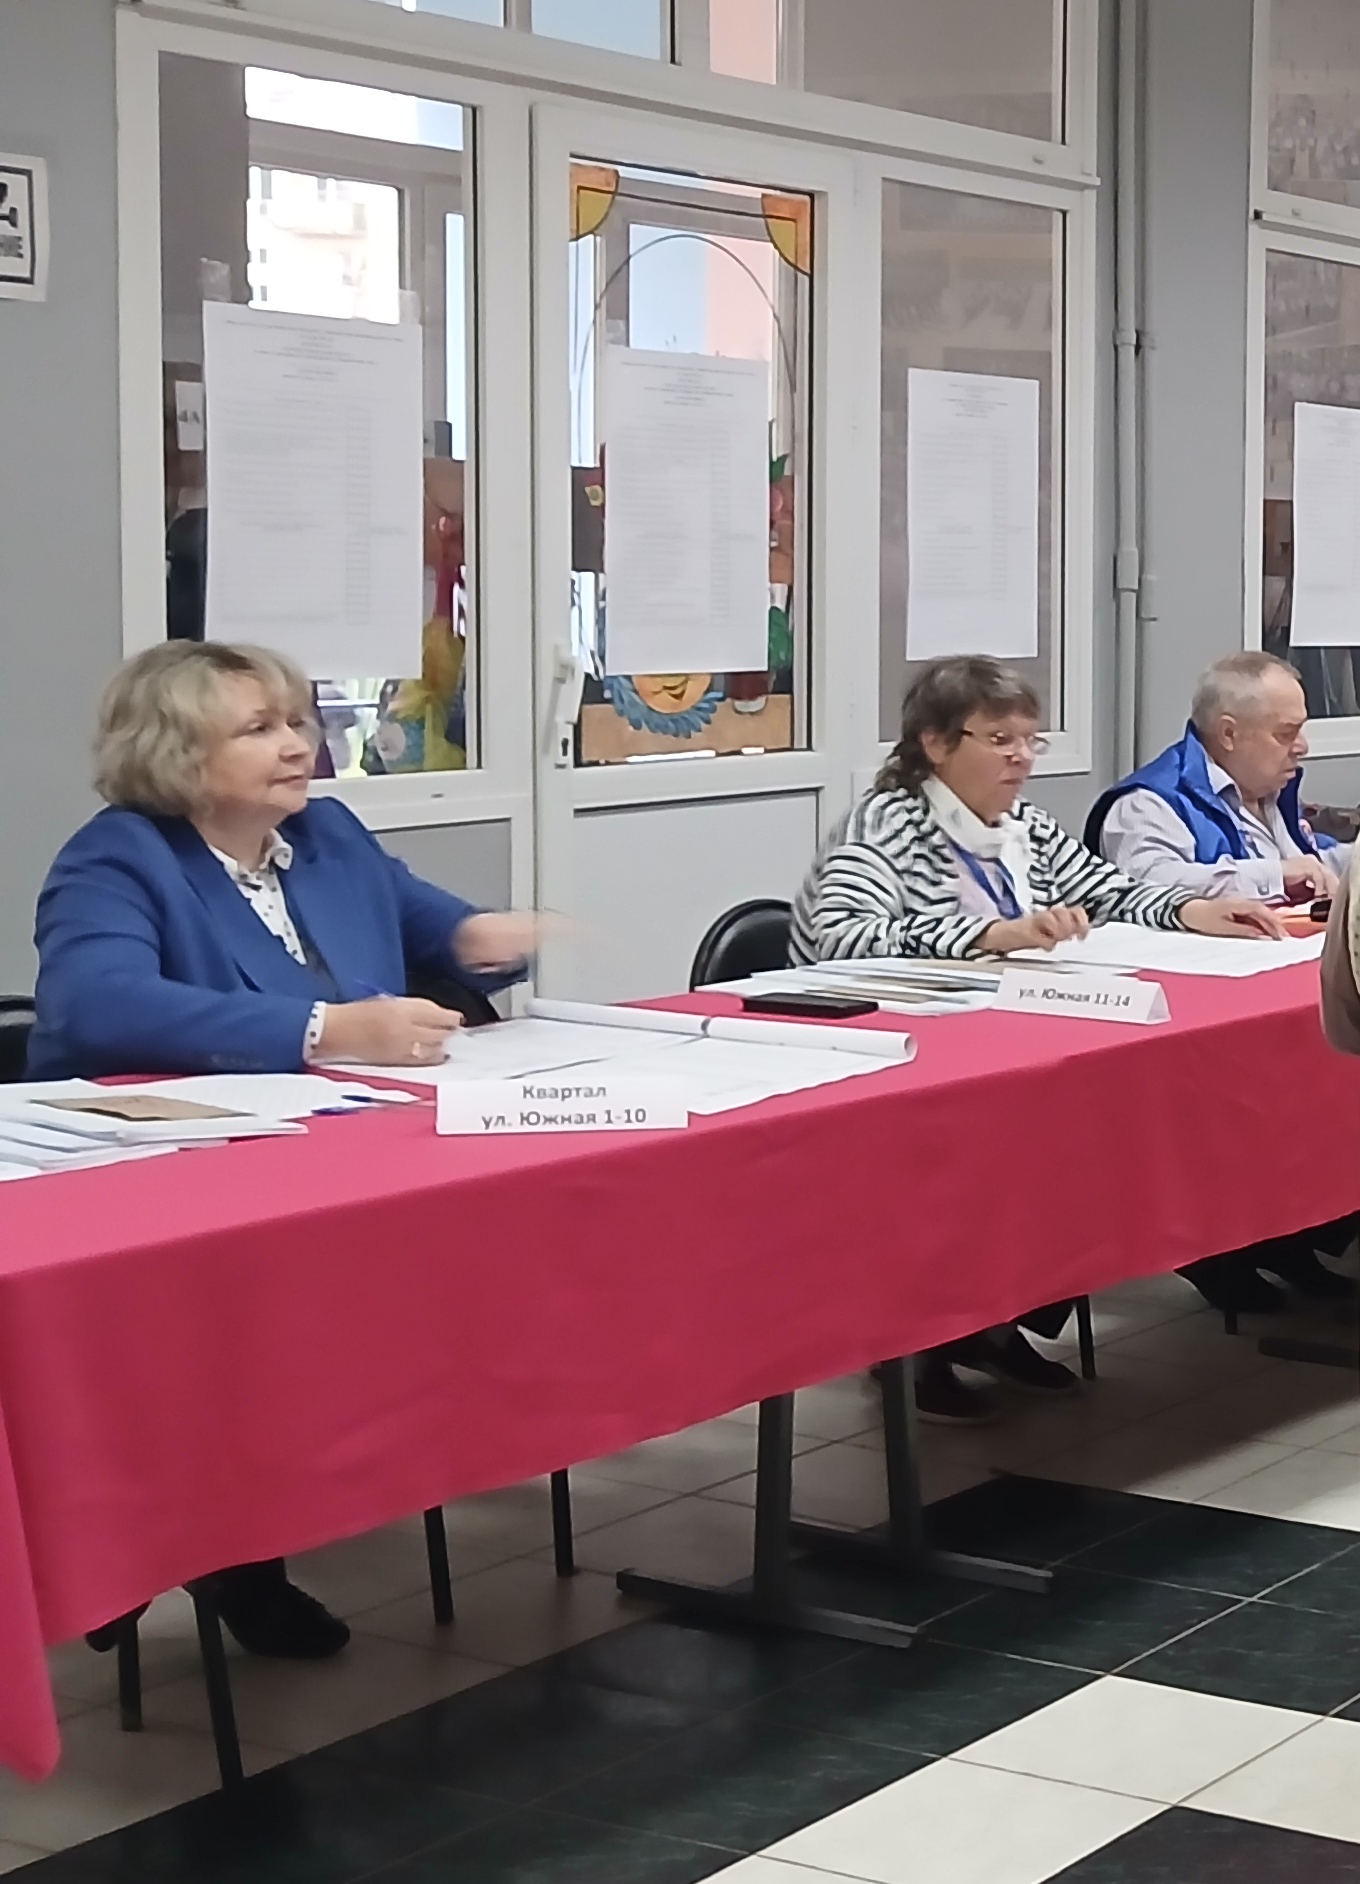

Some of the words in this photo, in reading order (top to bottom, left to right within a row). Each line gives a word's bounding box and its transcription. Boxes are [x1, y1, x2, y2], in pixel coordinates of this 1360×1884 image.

[1041, 988, 1090, 1002] Южная
[1094, 993, 1131, 1007] 11-14
[523, 1085, 606, 1101] Квартал
[481, 1115, 512, 1130] ул.
[519, 1110, 597, 1126] Южная
[604, 1108, 646, 1124] 1-10
